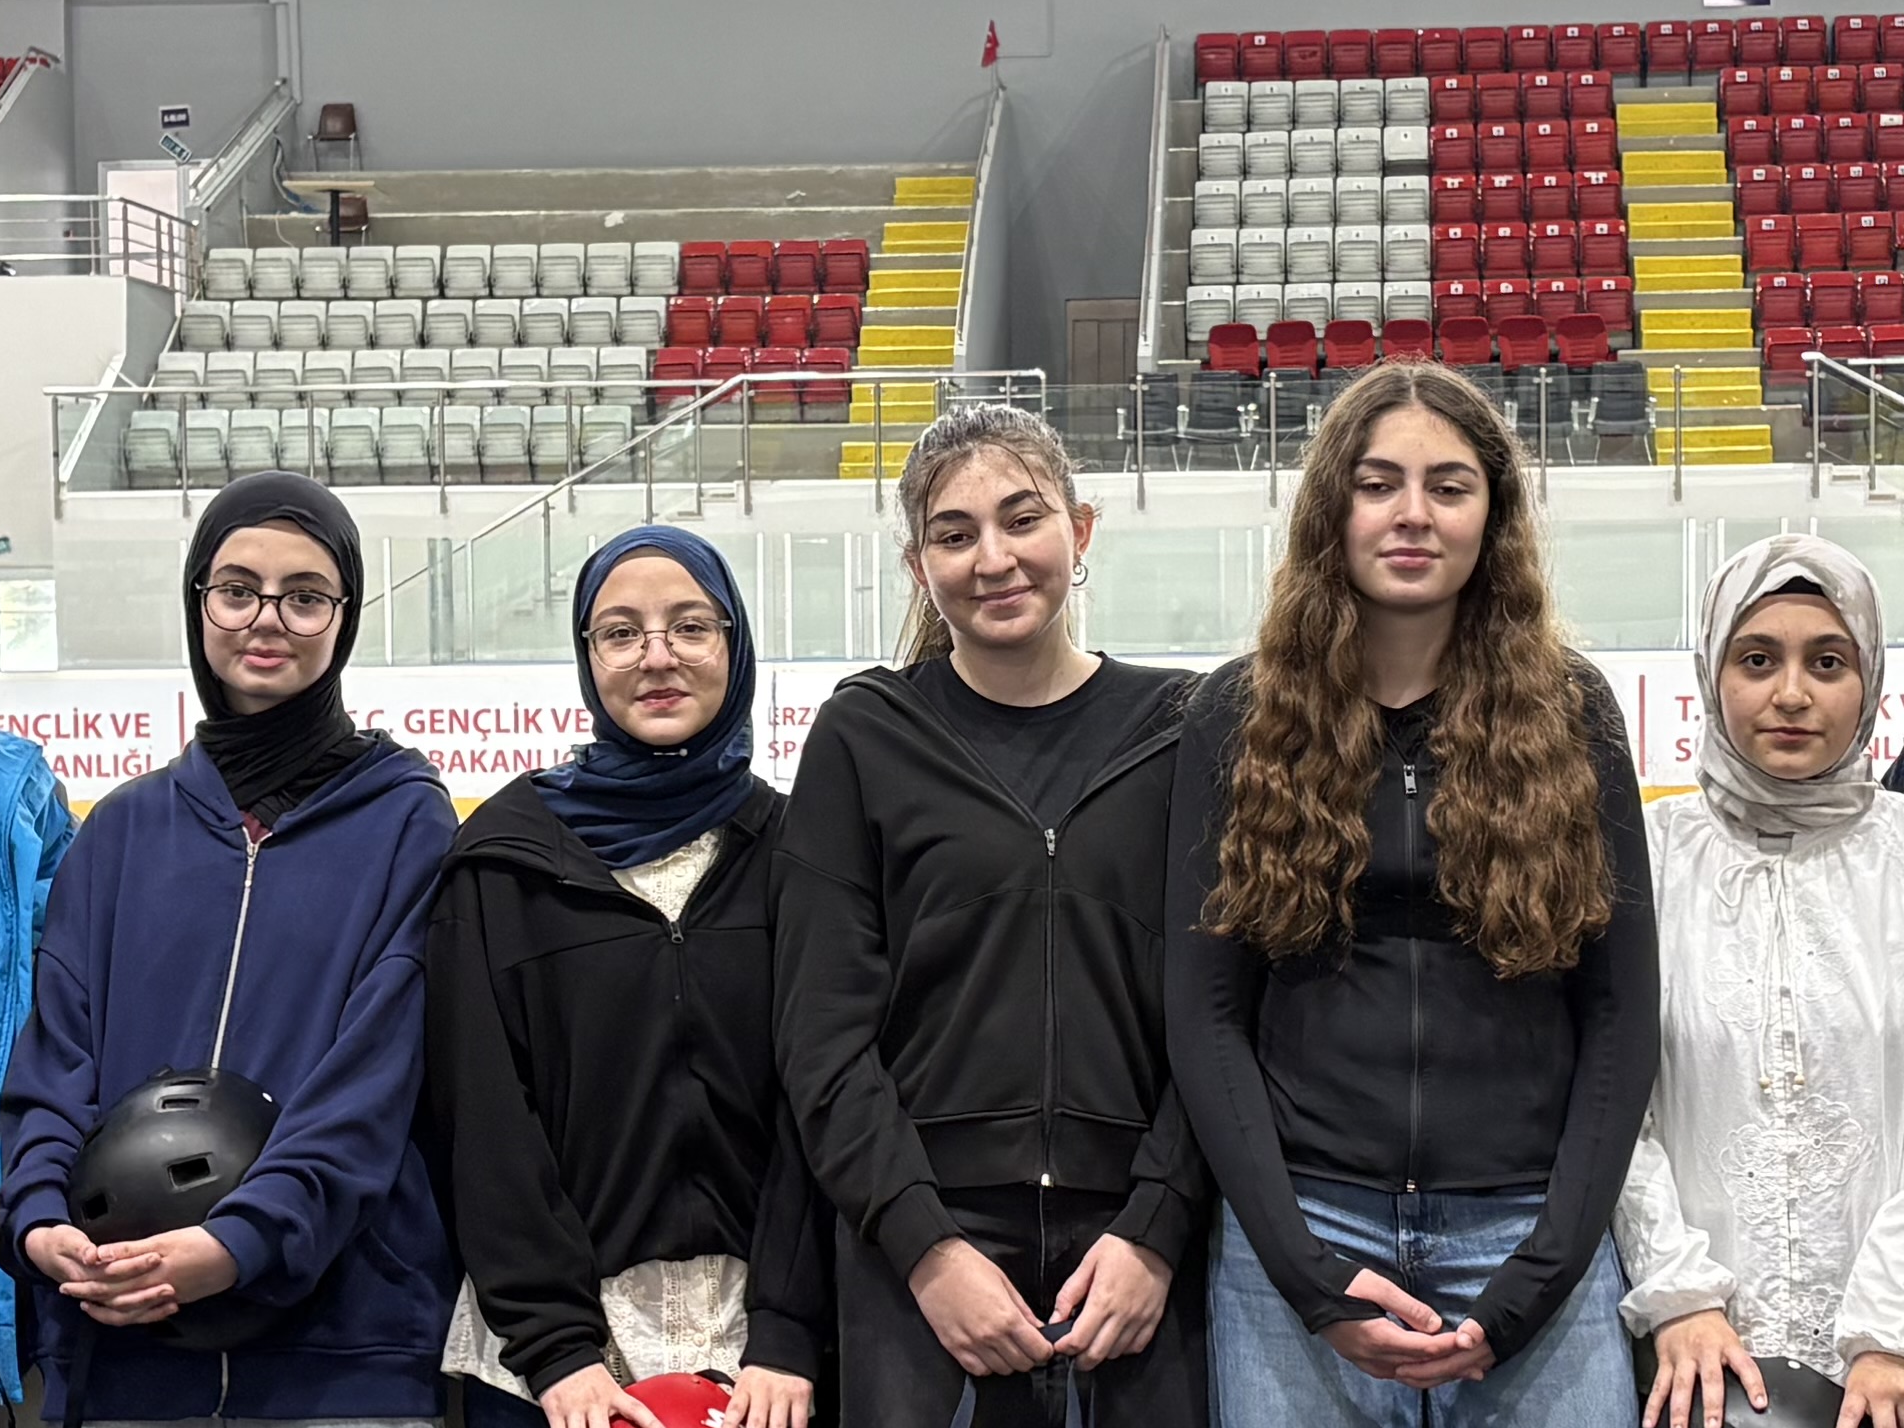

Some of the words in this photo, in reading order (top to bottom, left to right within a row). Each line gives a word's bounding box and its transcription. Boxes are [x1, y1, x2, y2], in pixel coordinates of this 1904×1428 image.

[110, 712, 151, 739] VE
[404, 702, 543, 742] GENÇLİK
[550, 708, 593, 734] VE
[52, 748, 152, 778] ANLIĞI
